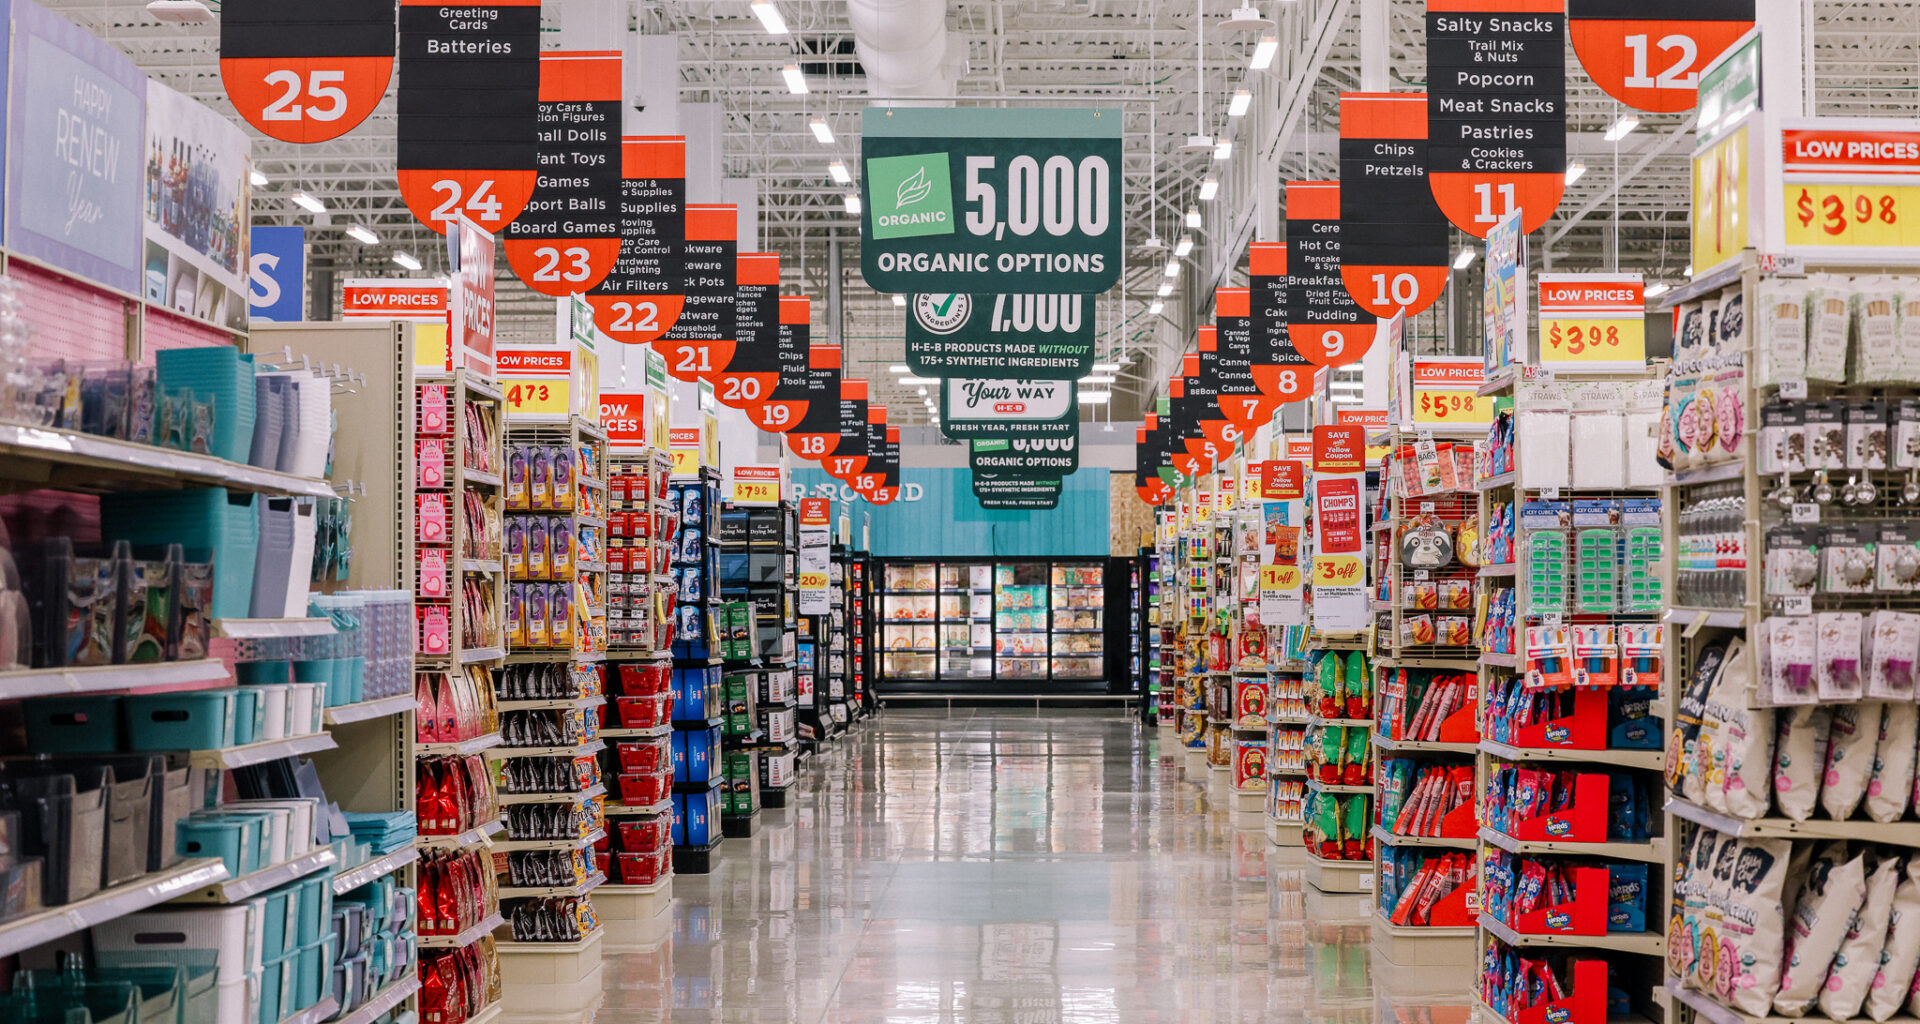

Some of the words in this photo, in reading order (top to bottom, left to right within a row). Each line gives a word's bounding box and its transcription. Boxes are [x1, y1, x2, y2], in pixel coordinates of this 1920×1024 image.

[439, 8, 498, 21] Greeting
[449, 20, 488, 30] Cards
[1436, 17, 1483, 35] Salty
[1489, 18, 1553, 32] Snacks
[427, 39, 512, 54] Batteries
[1468, 40, 1496, 51] Trail
[1501, 40, 1524, 51] Mix
[1474, 52, 1483, 62] &
[1488, 52, 1518, 62] Nuts
[1624, 33, 1699, 90] 12
[1457, 71, 1534, 88] Popcorn
[73, 74, 112, 124] HAPPY
[262, 70, 348, 121] 25
[556, 103, 582, 112] Cars
[585, 103, 593, 112] &
[1440, 98, 1484, 113] Meat
[1490, 98, 1554, 113] Snacks
[562, 113, 605, 123] Figures
[567, 129, 607, 142] Dolls
[1461, 125, 1534, 139] Pastries
[56, 108, 120, 184] RENEW
[1374, 143, 1415, 157] Chips
[1470, 147, 1524, 158] Cookies
[1795, 141, 1843, 158] LOW
[1848, 142, 1919, 160] PRICES
[571, 152, 606, 167] Toys
[1461, 159, 1471, 169] &
[1475, 159, 1534, 170] Crackers
[1365, 163, 1424, 176] Pretzels
[537, 176, 590, 188] Games
[649, 180, 657, 188] &
[631, 188, 673, 198] Supplies
[965, 154, 1110, 241] 5,000
[430, 180, 502, 221] 24
[568, 198, 606, 211] Balls
[1474, 183, 1515, 223] 11
[620, 202, 677, 215] Supplies
[1797, 188, 1897, 236] $398
[878, 210, 947, 227] ORGANIC
[510, 221, 557, 234] Board
[563, 221, 616, 234] Games
[1312, 223, 1340, 233] Cere
[637, 238, 660, 246] Care
[1299, 240, 1322, 250] Hot
[634, 246, 671, 254] Control
[533, 246, 591, 282] 23
[877, 252, 990, 273] ORGANIC
[997, 253, 1105, 273] OPTIONS
[620, 265, 661, 275] Lighting
[601, 280, 622, 291] Air
[626, 280, 669, 291] Filters
[699, 277, 725, 286] Pots
[1371, 272, 1419, 306] 10
[1549, 290, 1583, 301] LOW
[1585, 289, 1634, 301] PRICES
[352, 294, 386, 305] LOW
[388, 294, 439, 305] PRICES
[1333, 298, 1355, 306] Cups
[463, 291, 491, 339] PRICES
[609, 302, 659, 332] 22
[1307, 310, 1357, 321] Pudding
[689, 332, 723, 340] Storage
[1550, 321, 1619, 354] $398
[911, 342, 942, 352] H-E-B
[944, 343, 1002, 353] PRODUCTS
[1004, 344, 1036, 353] MADE
[1038, 344, 1089, 355] WITHOUT
[1321, 330, 1345, 358] 9
[523, 356, 563, 366] PRICES
[676, 346, 712, 372] 21
[778, 352, 804, 360] Chips
[920, 355, 944, 365] 175+
[946, 356, 1005, 366] SYNTHETIC
[1008, 357, 1080, 368] INGREDIENTS
[1271, 353, 1305, 362] Spices
[1421, 368, 1447, 377] LOW
[1448, 368, 1485, 378] PRICES
[723, 377, 761, 400] 20
[1278, 370, 1298, 394] 8
[962, 381, 1012, 409] Your
[1016, 388, 1055, 399] WAY
[1527, 392, 1562, 400] STRAWS
[1580, 392, 1615, 400] STRAWS
[1242, 399, 1259, 420] 7
[1421, 392, 1474, 418] $598
[762, 404, 790, 425] 19
[1343, 415, 1364, 423] LOW
[981, 424, 1008, 432] YEAR,
[1221, 424, 1237, 441] 6
[801, 436, 825, 454] 18
[1204, 442, 1217, 458] 5
[975, 457, 1023, 466] ORGANIC
[1026, 457, 1072, 467] OPTIONS
[1418, 451, 1436, 462] BAGS
[834, 459, 854, 474] 17
[1186, 458, 1199, 472] 4
[855, 476, 875, 490] 16
[1173, 471, 1184, 484] 3
[872, 489, 889, 501] 15
[1323, 496, 1354, 509] CHOMPS
[1263, 570, 1275, 584] $1
[1278, 570, 1294, 584] off
[1317, 562, 1336, 579] $3
[1337, 562, 1357, 578] off
